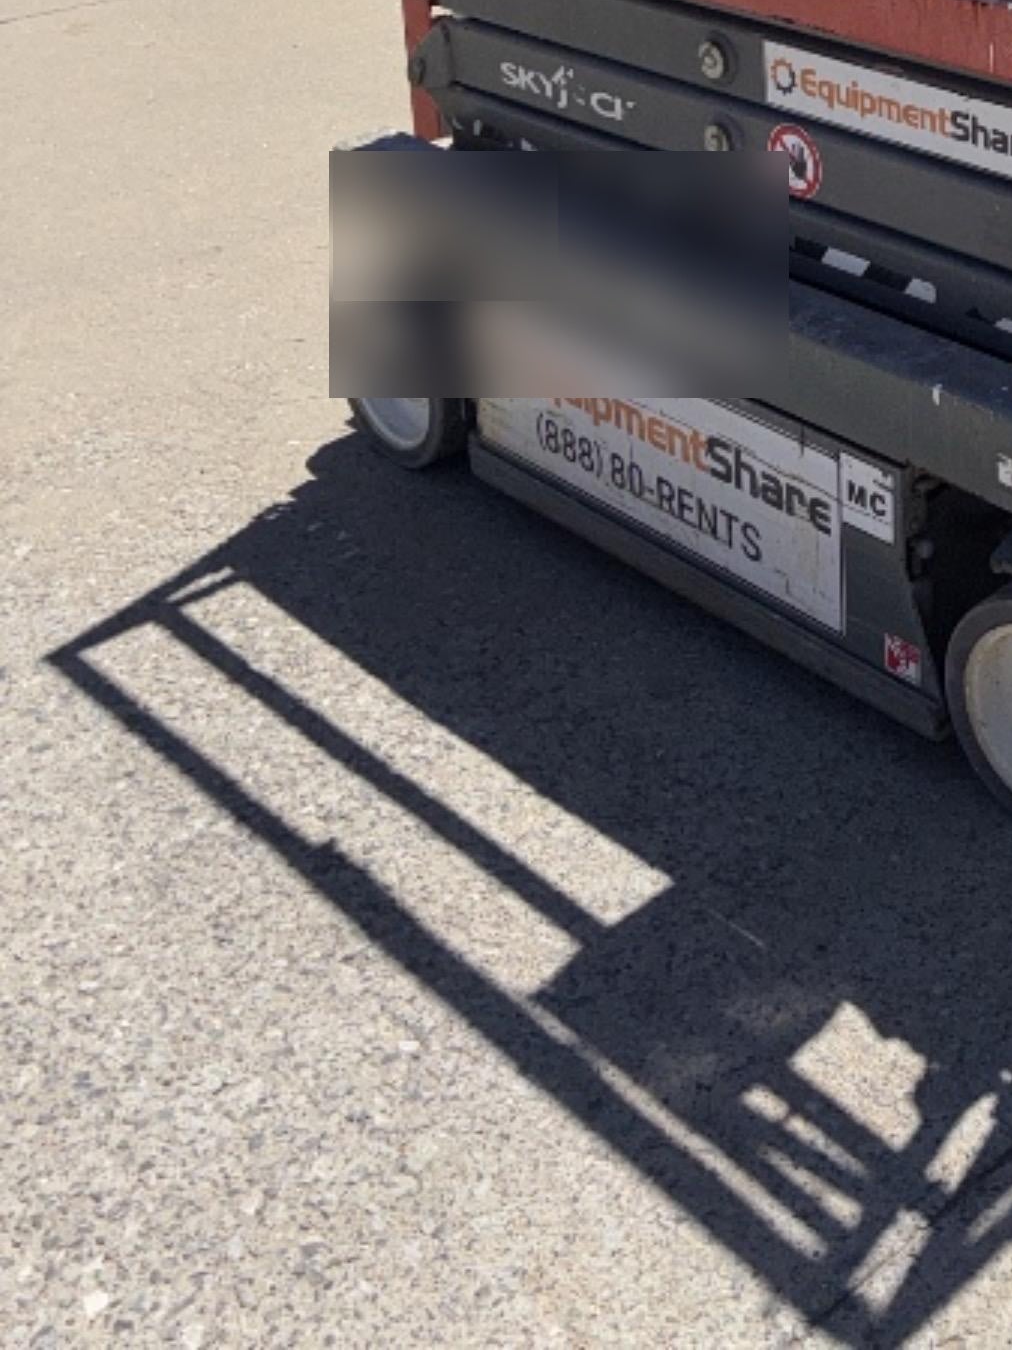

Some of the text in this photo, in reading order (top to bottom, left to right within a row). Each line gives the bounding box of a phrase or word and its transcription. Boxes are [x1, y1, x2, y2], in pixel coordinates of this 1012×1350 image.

[536, 412, 764, 564] (888) 80-RENTS
[847, 480, 888, 518] MC
